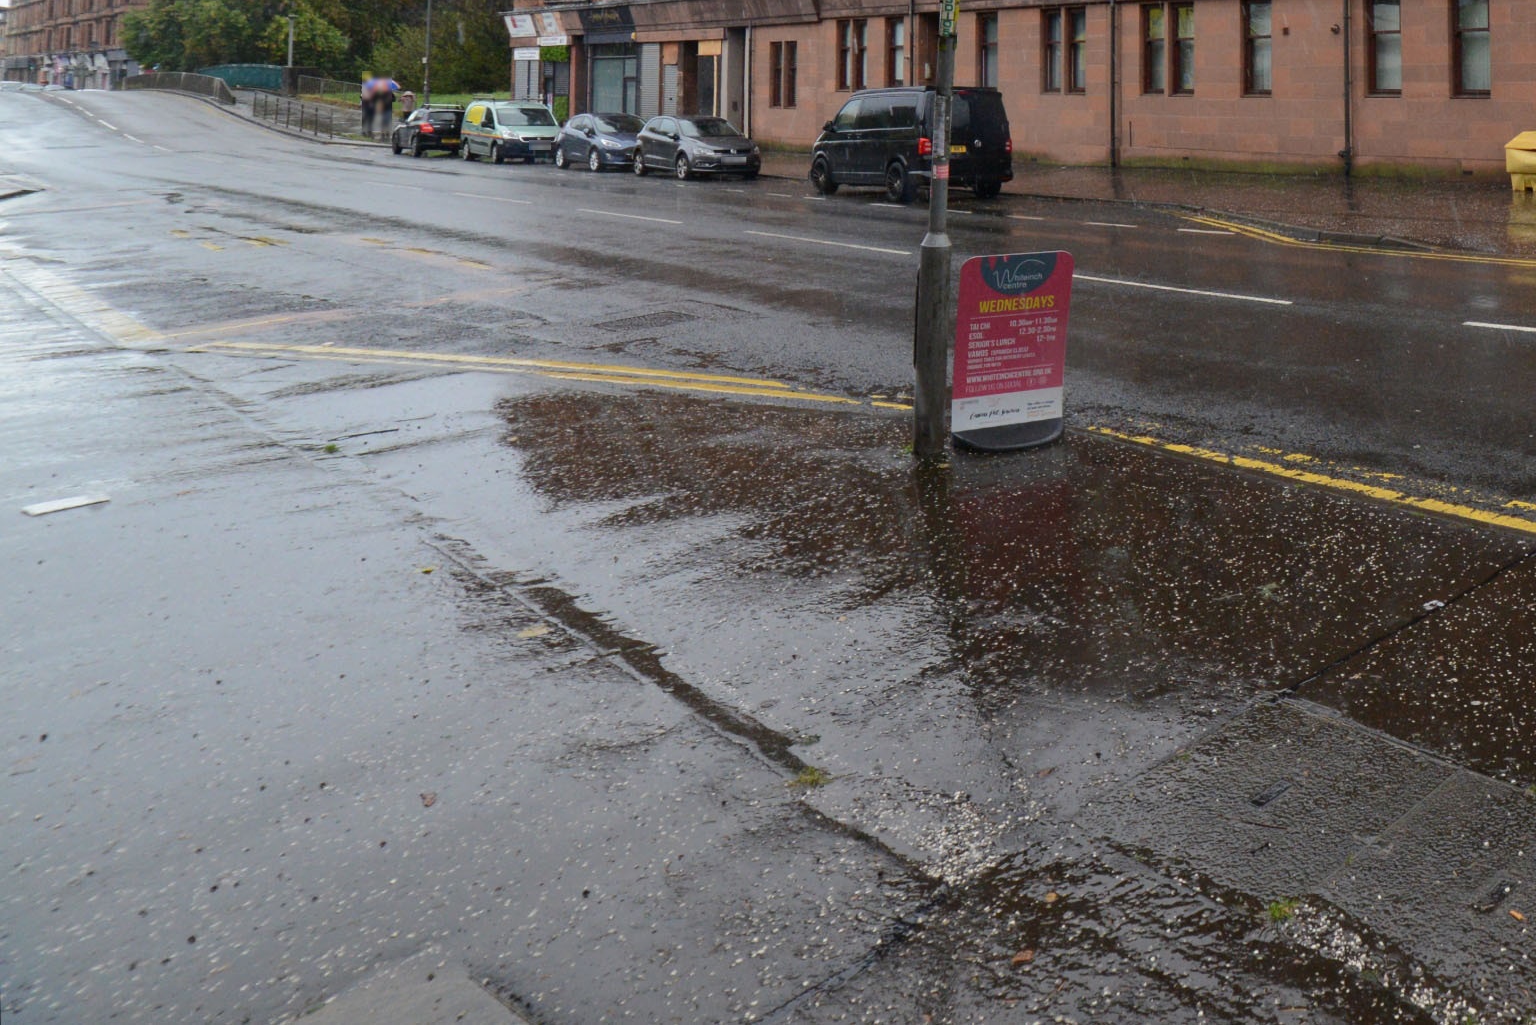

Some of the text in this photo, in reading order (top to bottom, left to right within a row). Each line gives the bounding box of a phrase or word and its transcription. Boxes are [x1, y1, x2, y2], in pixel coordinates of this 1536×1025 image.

[1002, 281, 1027, 290] centre
[979, 295, 1055, 314] WEDNESDAYS
[996, 337, 1016, 347] LUNCH
